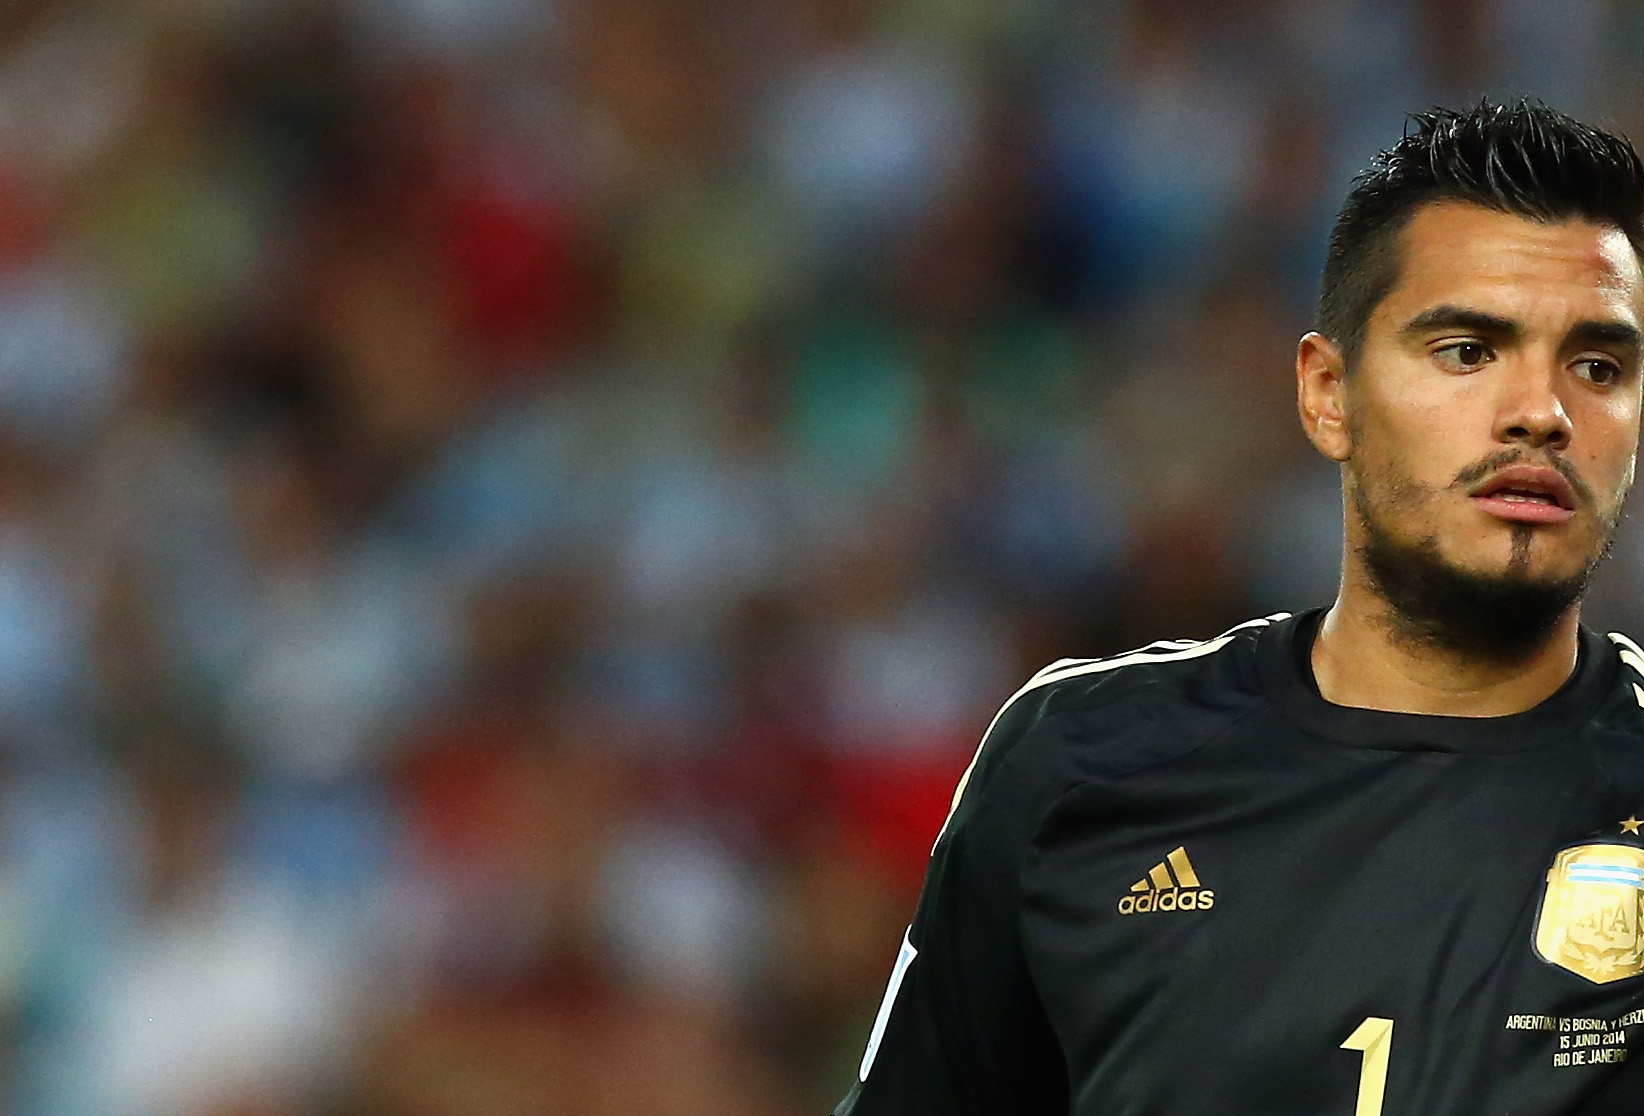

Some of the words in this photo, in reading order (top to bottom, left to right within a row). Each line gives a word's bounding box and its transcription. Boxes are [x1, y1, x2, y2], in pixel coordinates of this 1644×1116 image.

[1118, 887, 1215, 915] adidas
[1559, 1016, 1571, 1032] VS
[1572, 1018, 1608, 1031] BOSNIA
[1610, 1019, 1617, 1030] Y
[1559, 1035, 1570, 1049] 15
[1571, 1033, 1600, 1048] JUNIO
[1602, 1030, 1625, 1046] 2014
[1553, 1052, 1570, 1067] RIO
[1572, 1050, 1586, 1066] DE
